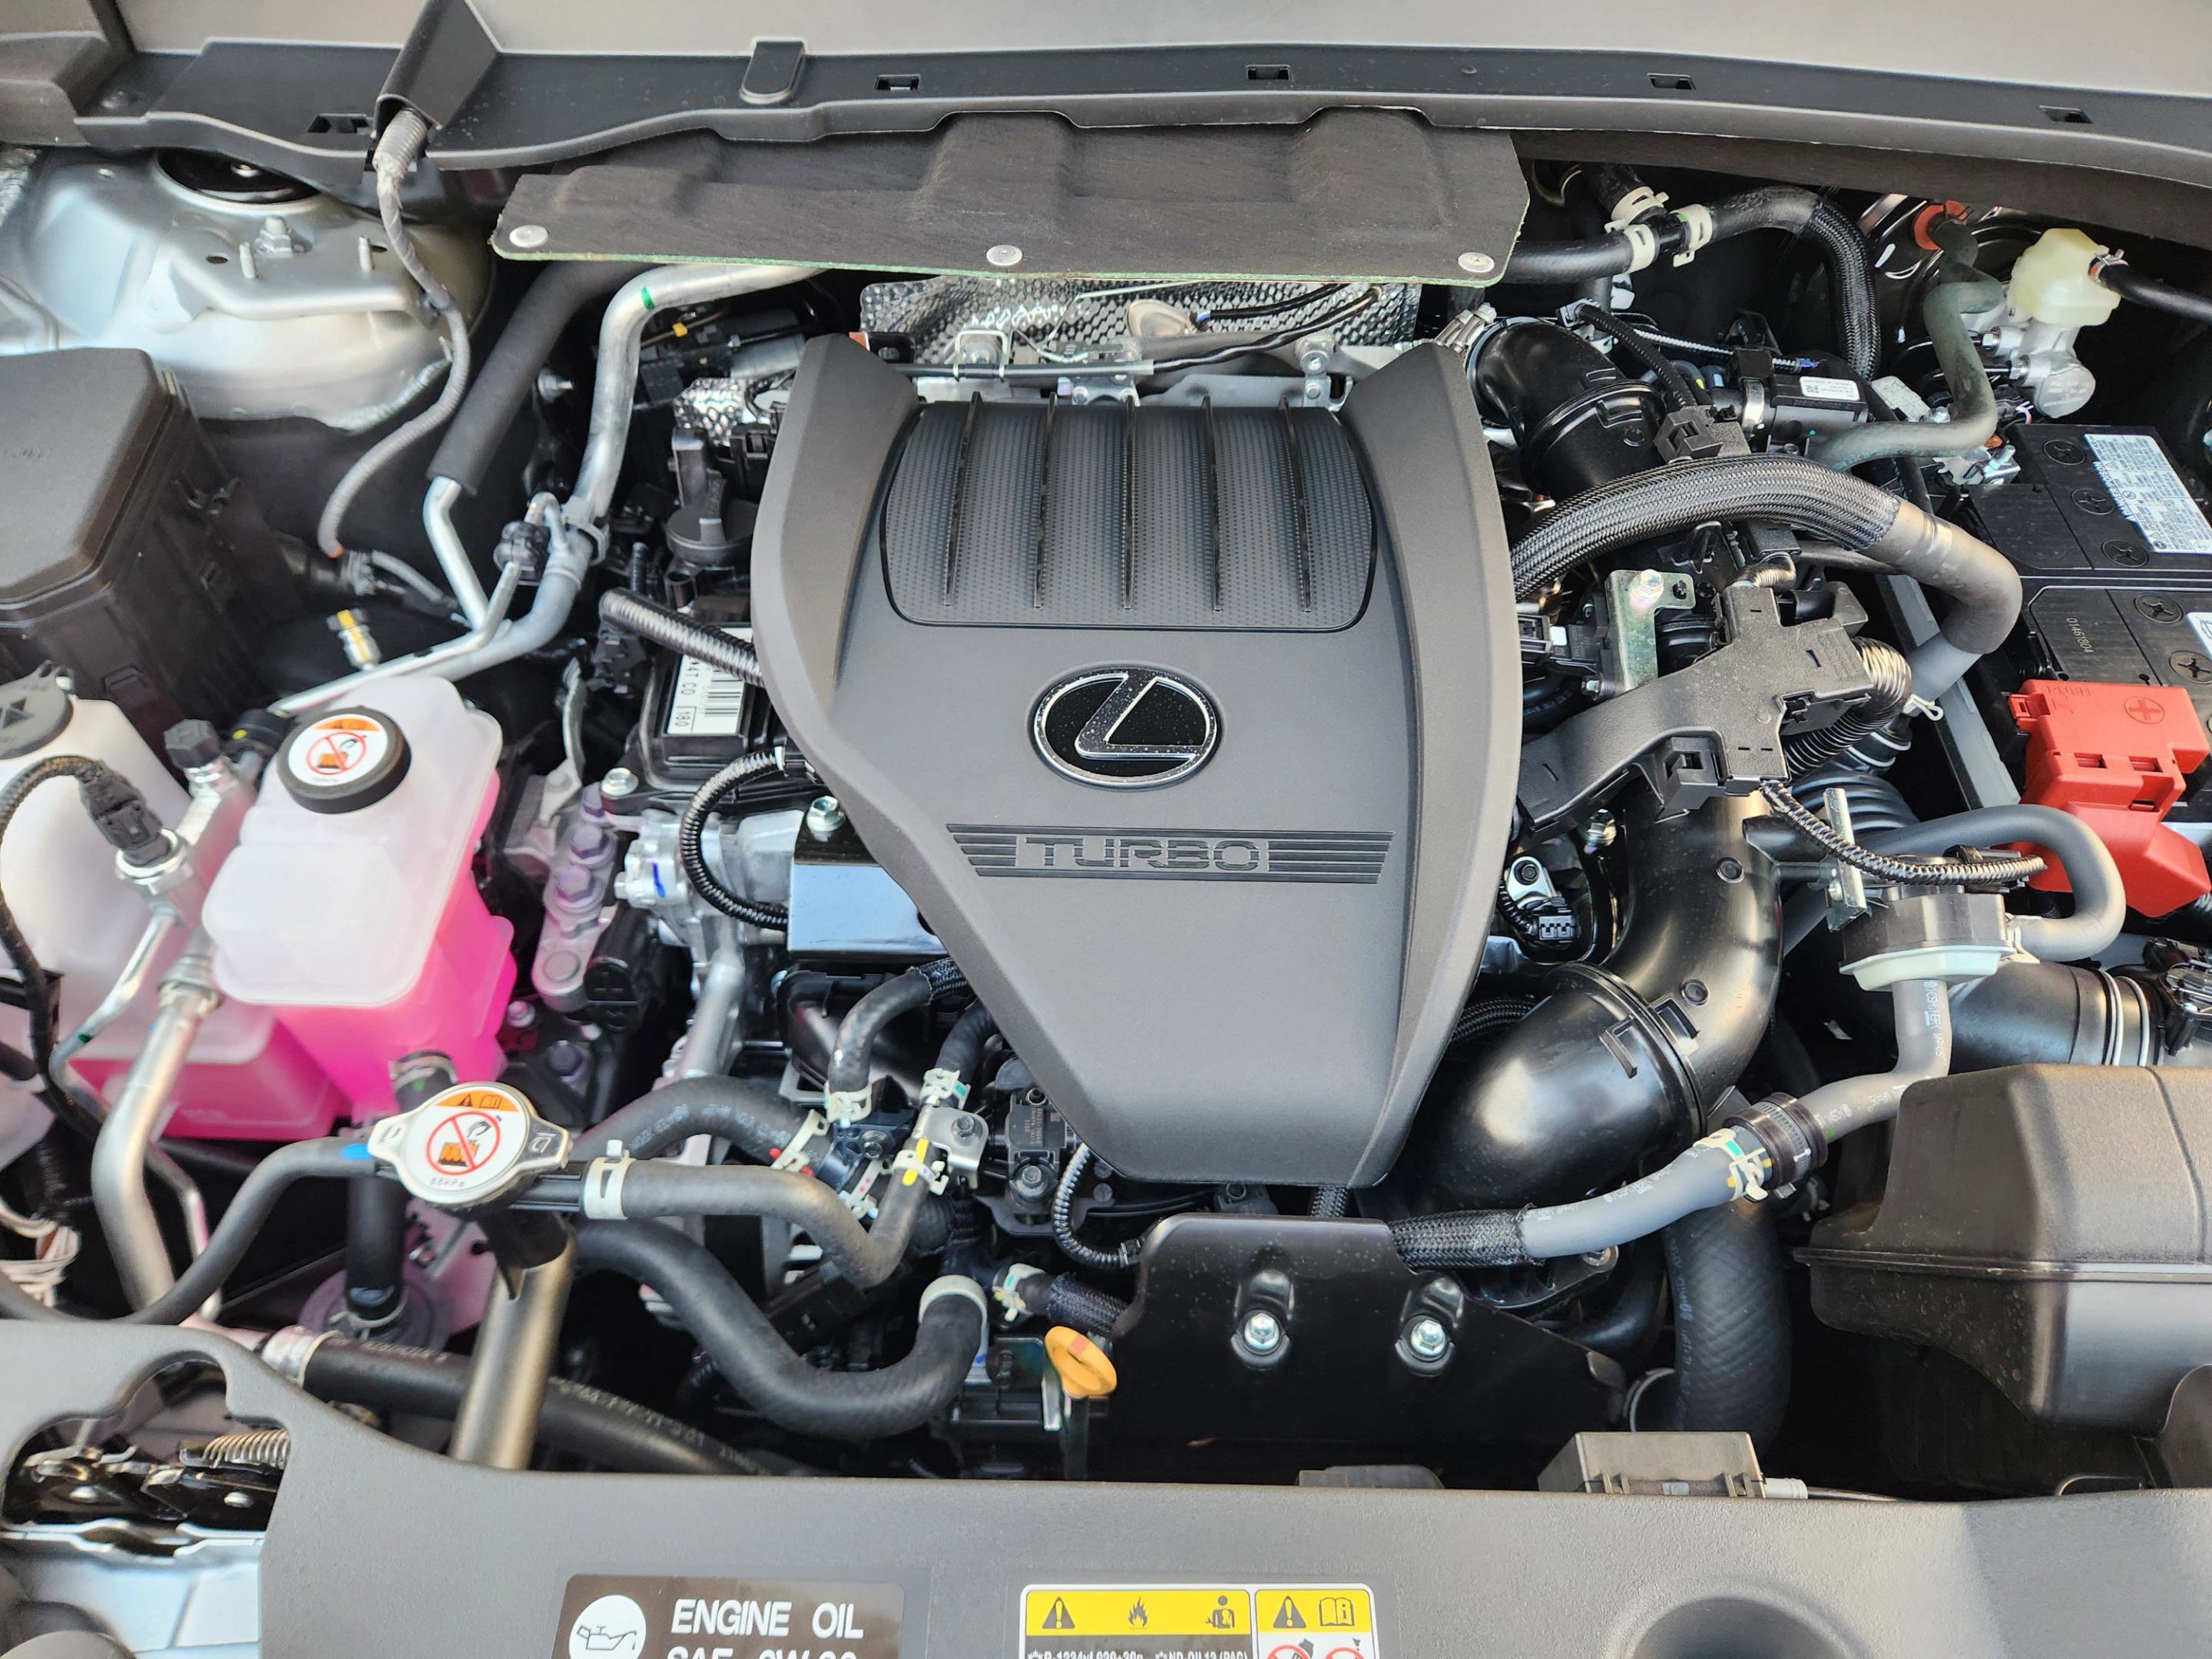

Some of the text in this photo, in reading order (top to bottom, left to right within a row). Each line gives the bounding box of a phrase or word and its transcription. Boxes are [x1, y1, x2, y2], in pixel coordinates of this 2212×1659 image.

[1025, 836, 1260, 871] TURBO
[671, 1598, 865, 1640] ENGINE OIL
